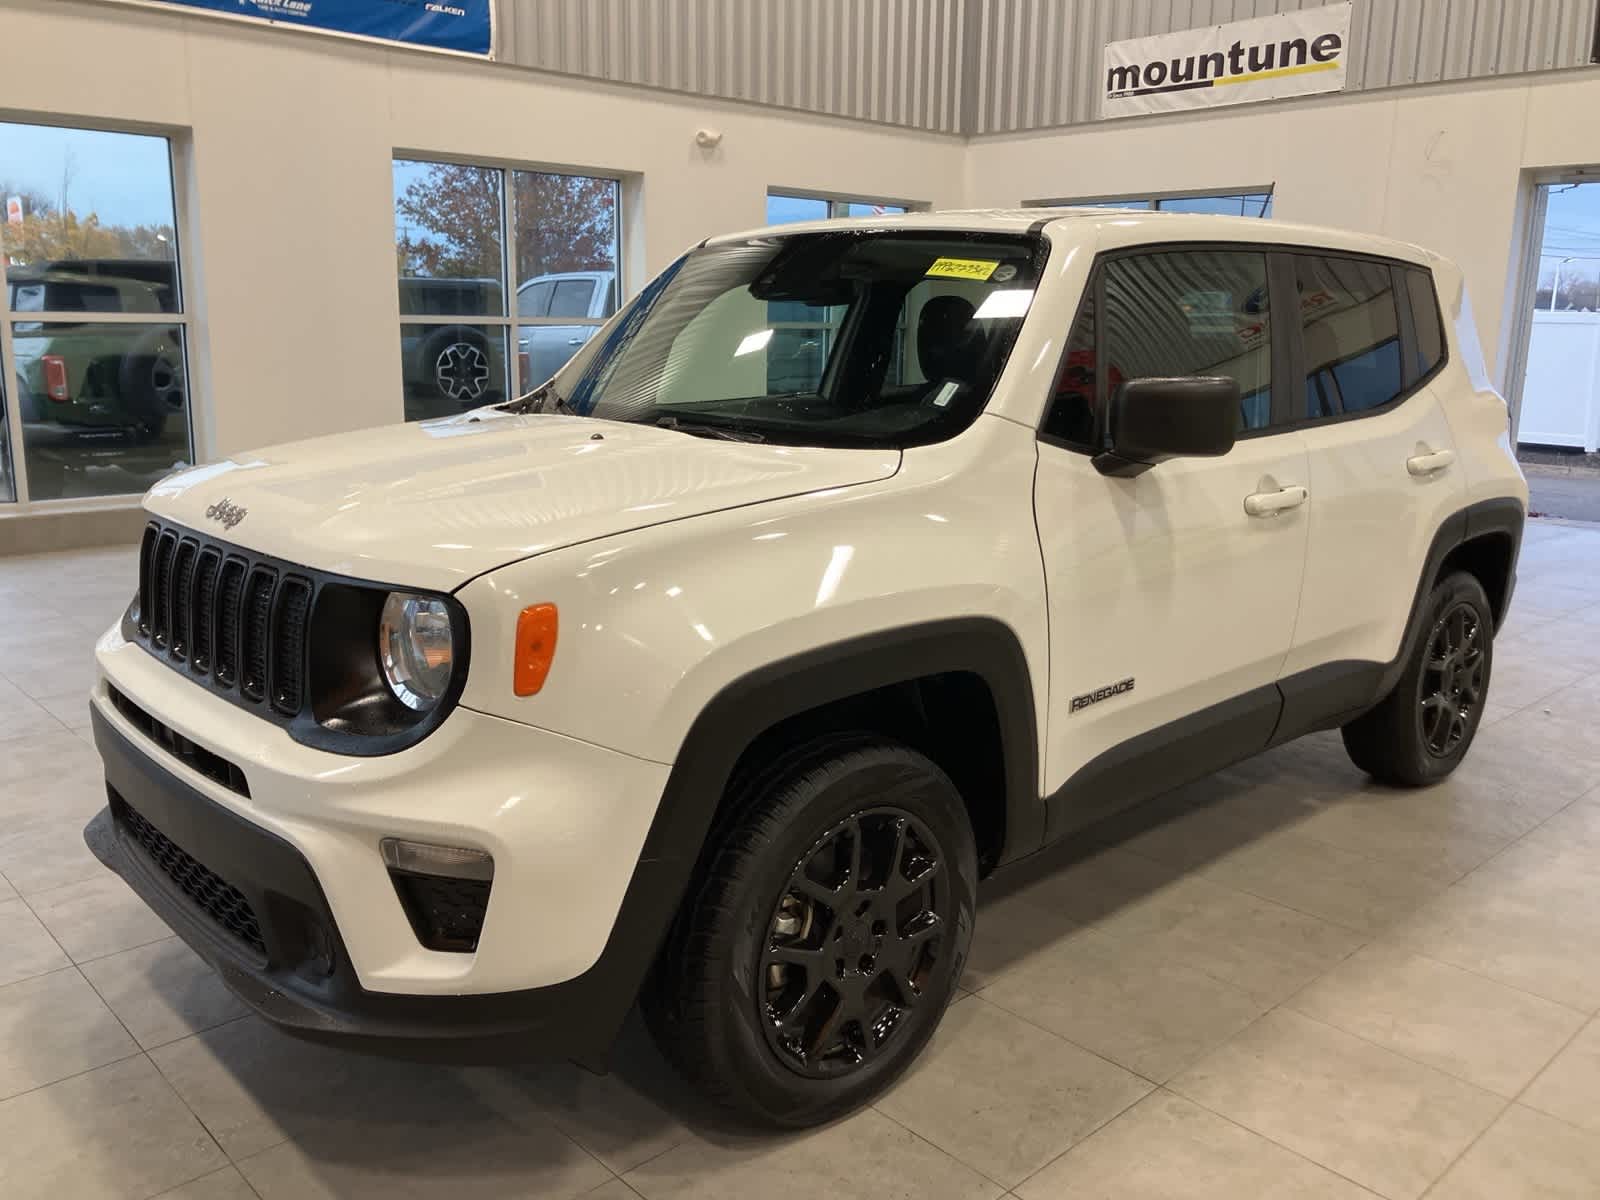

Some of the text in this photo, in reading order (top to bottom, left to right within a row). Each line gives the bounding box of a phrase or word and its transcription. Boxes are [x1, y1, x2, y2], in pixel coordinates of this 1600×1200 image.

[282, 0, 312, 12] Lane
[1107, 33, 1342, 92] mountune
[206, 498, 247, 530] Jeep
[1070, 678, 1135, 713] RENEGADE
